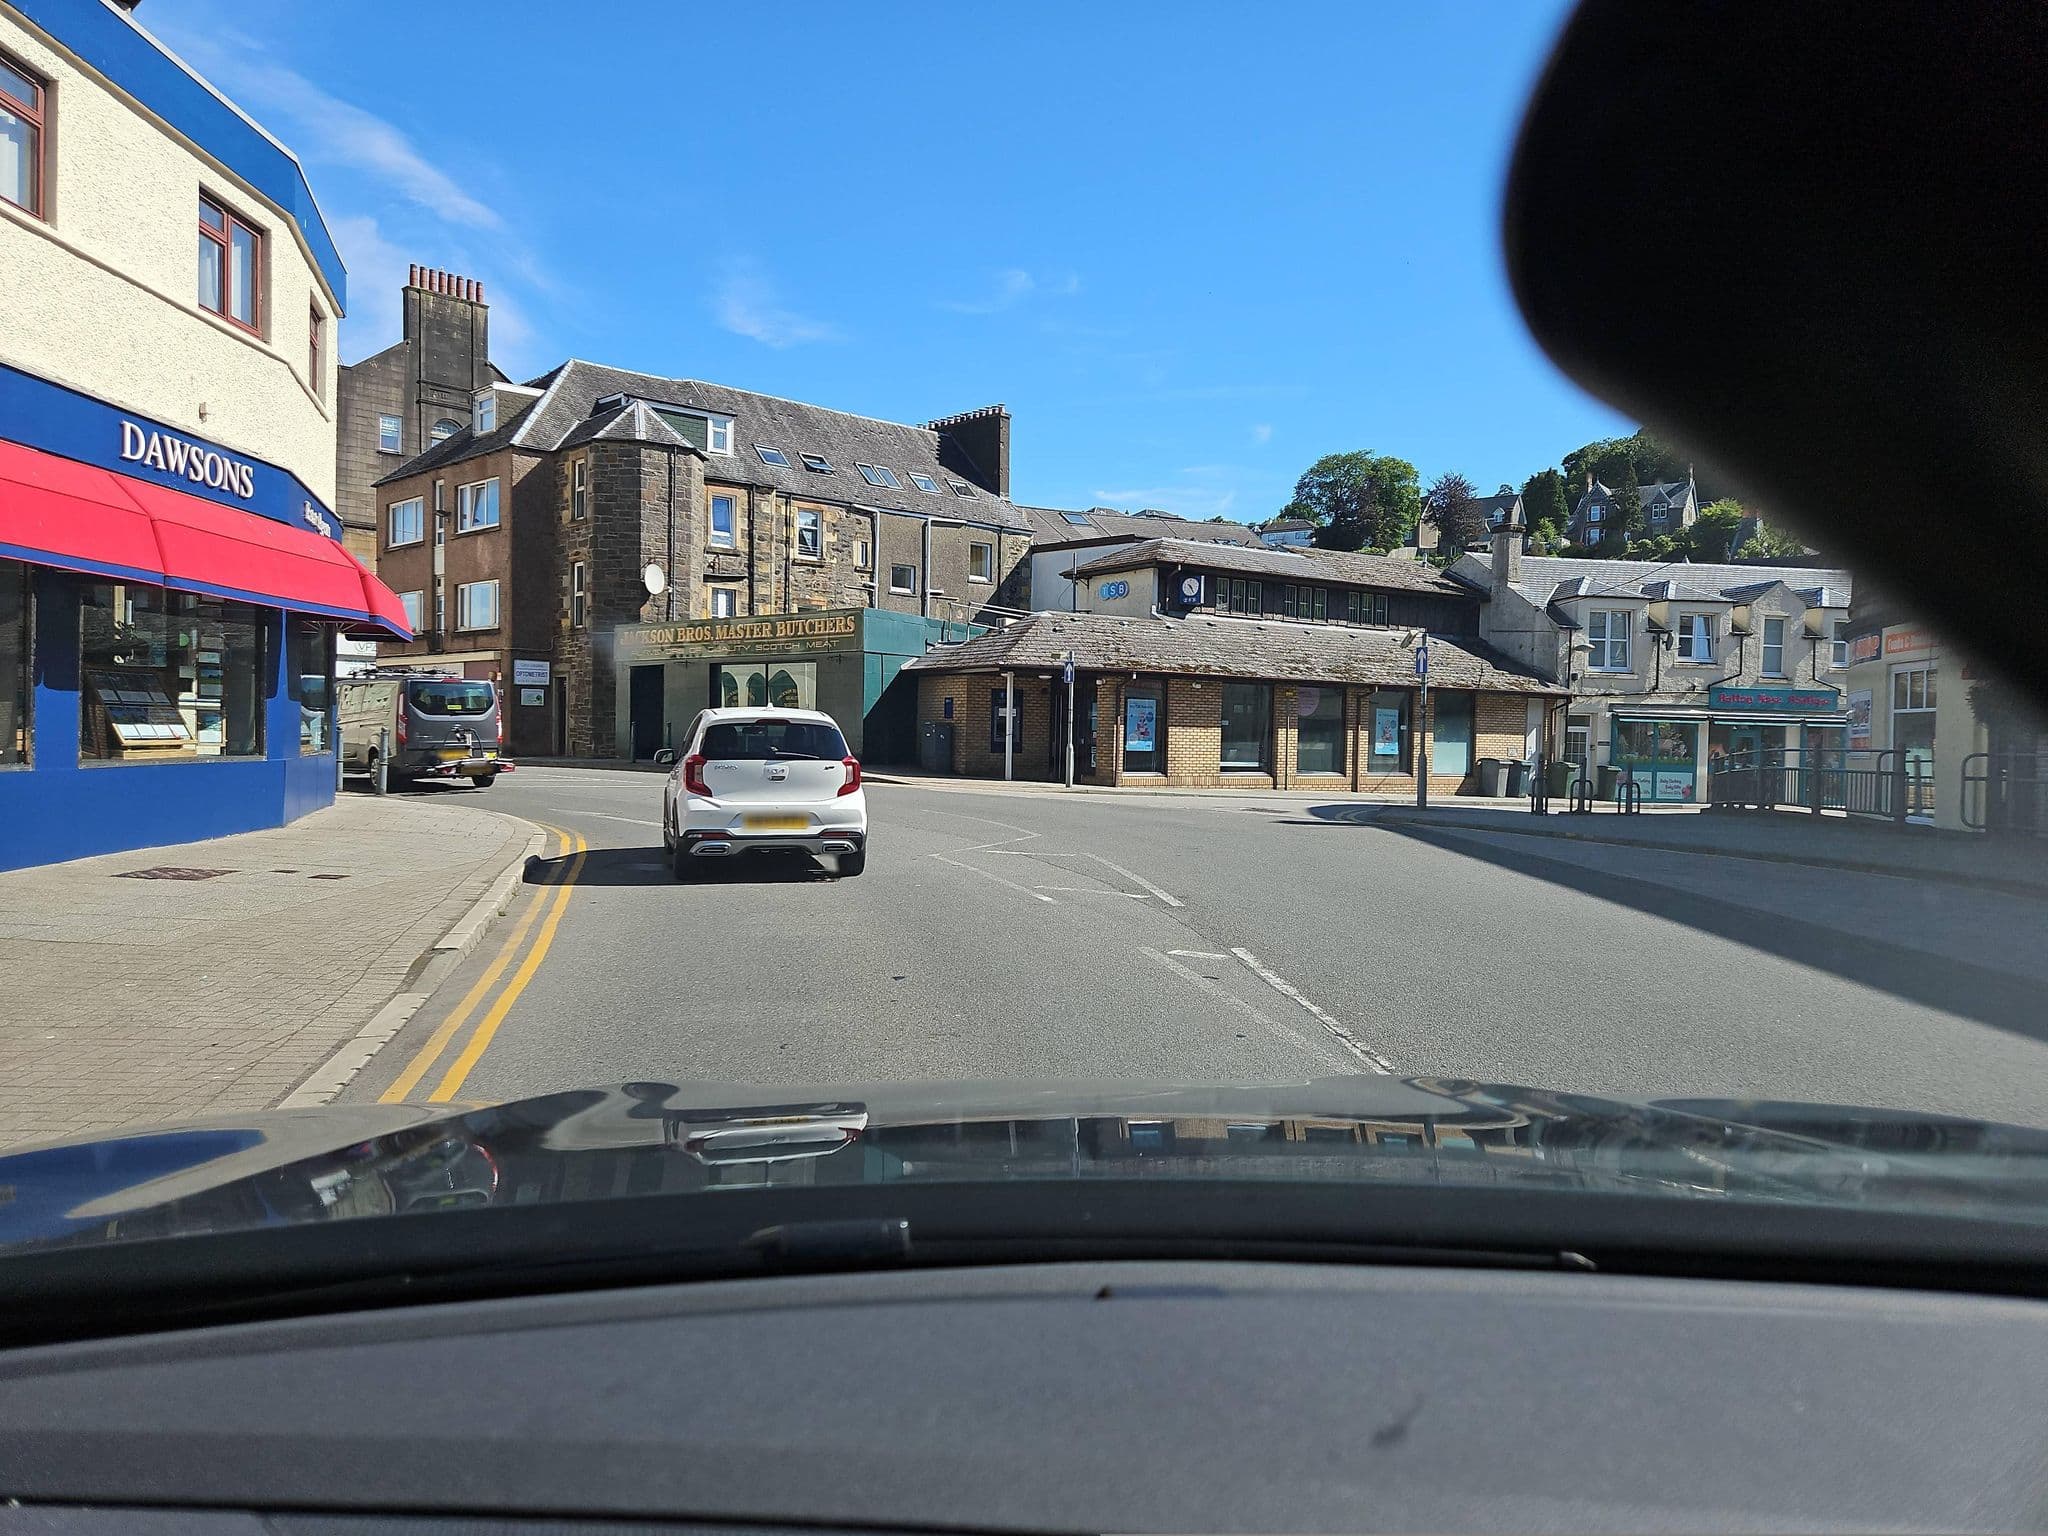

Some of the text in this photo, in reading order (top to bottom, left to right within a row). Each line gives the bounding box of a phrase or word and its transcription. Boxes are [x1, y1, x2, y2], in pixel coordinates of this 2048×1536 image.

[120, 420, 253, 498] DAWSONS
[1101, 582, 1125, 598] TSB
[621, 616, 856, 645] JACKSON BROS. MASTER BUTCHERS
[756, 642, 800, 652] SCOTCH
[806, 640, 840, 649] MEAT
